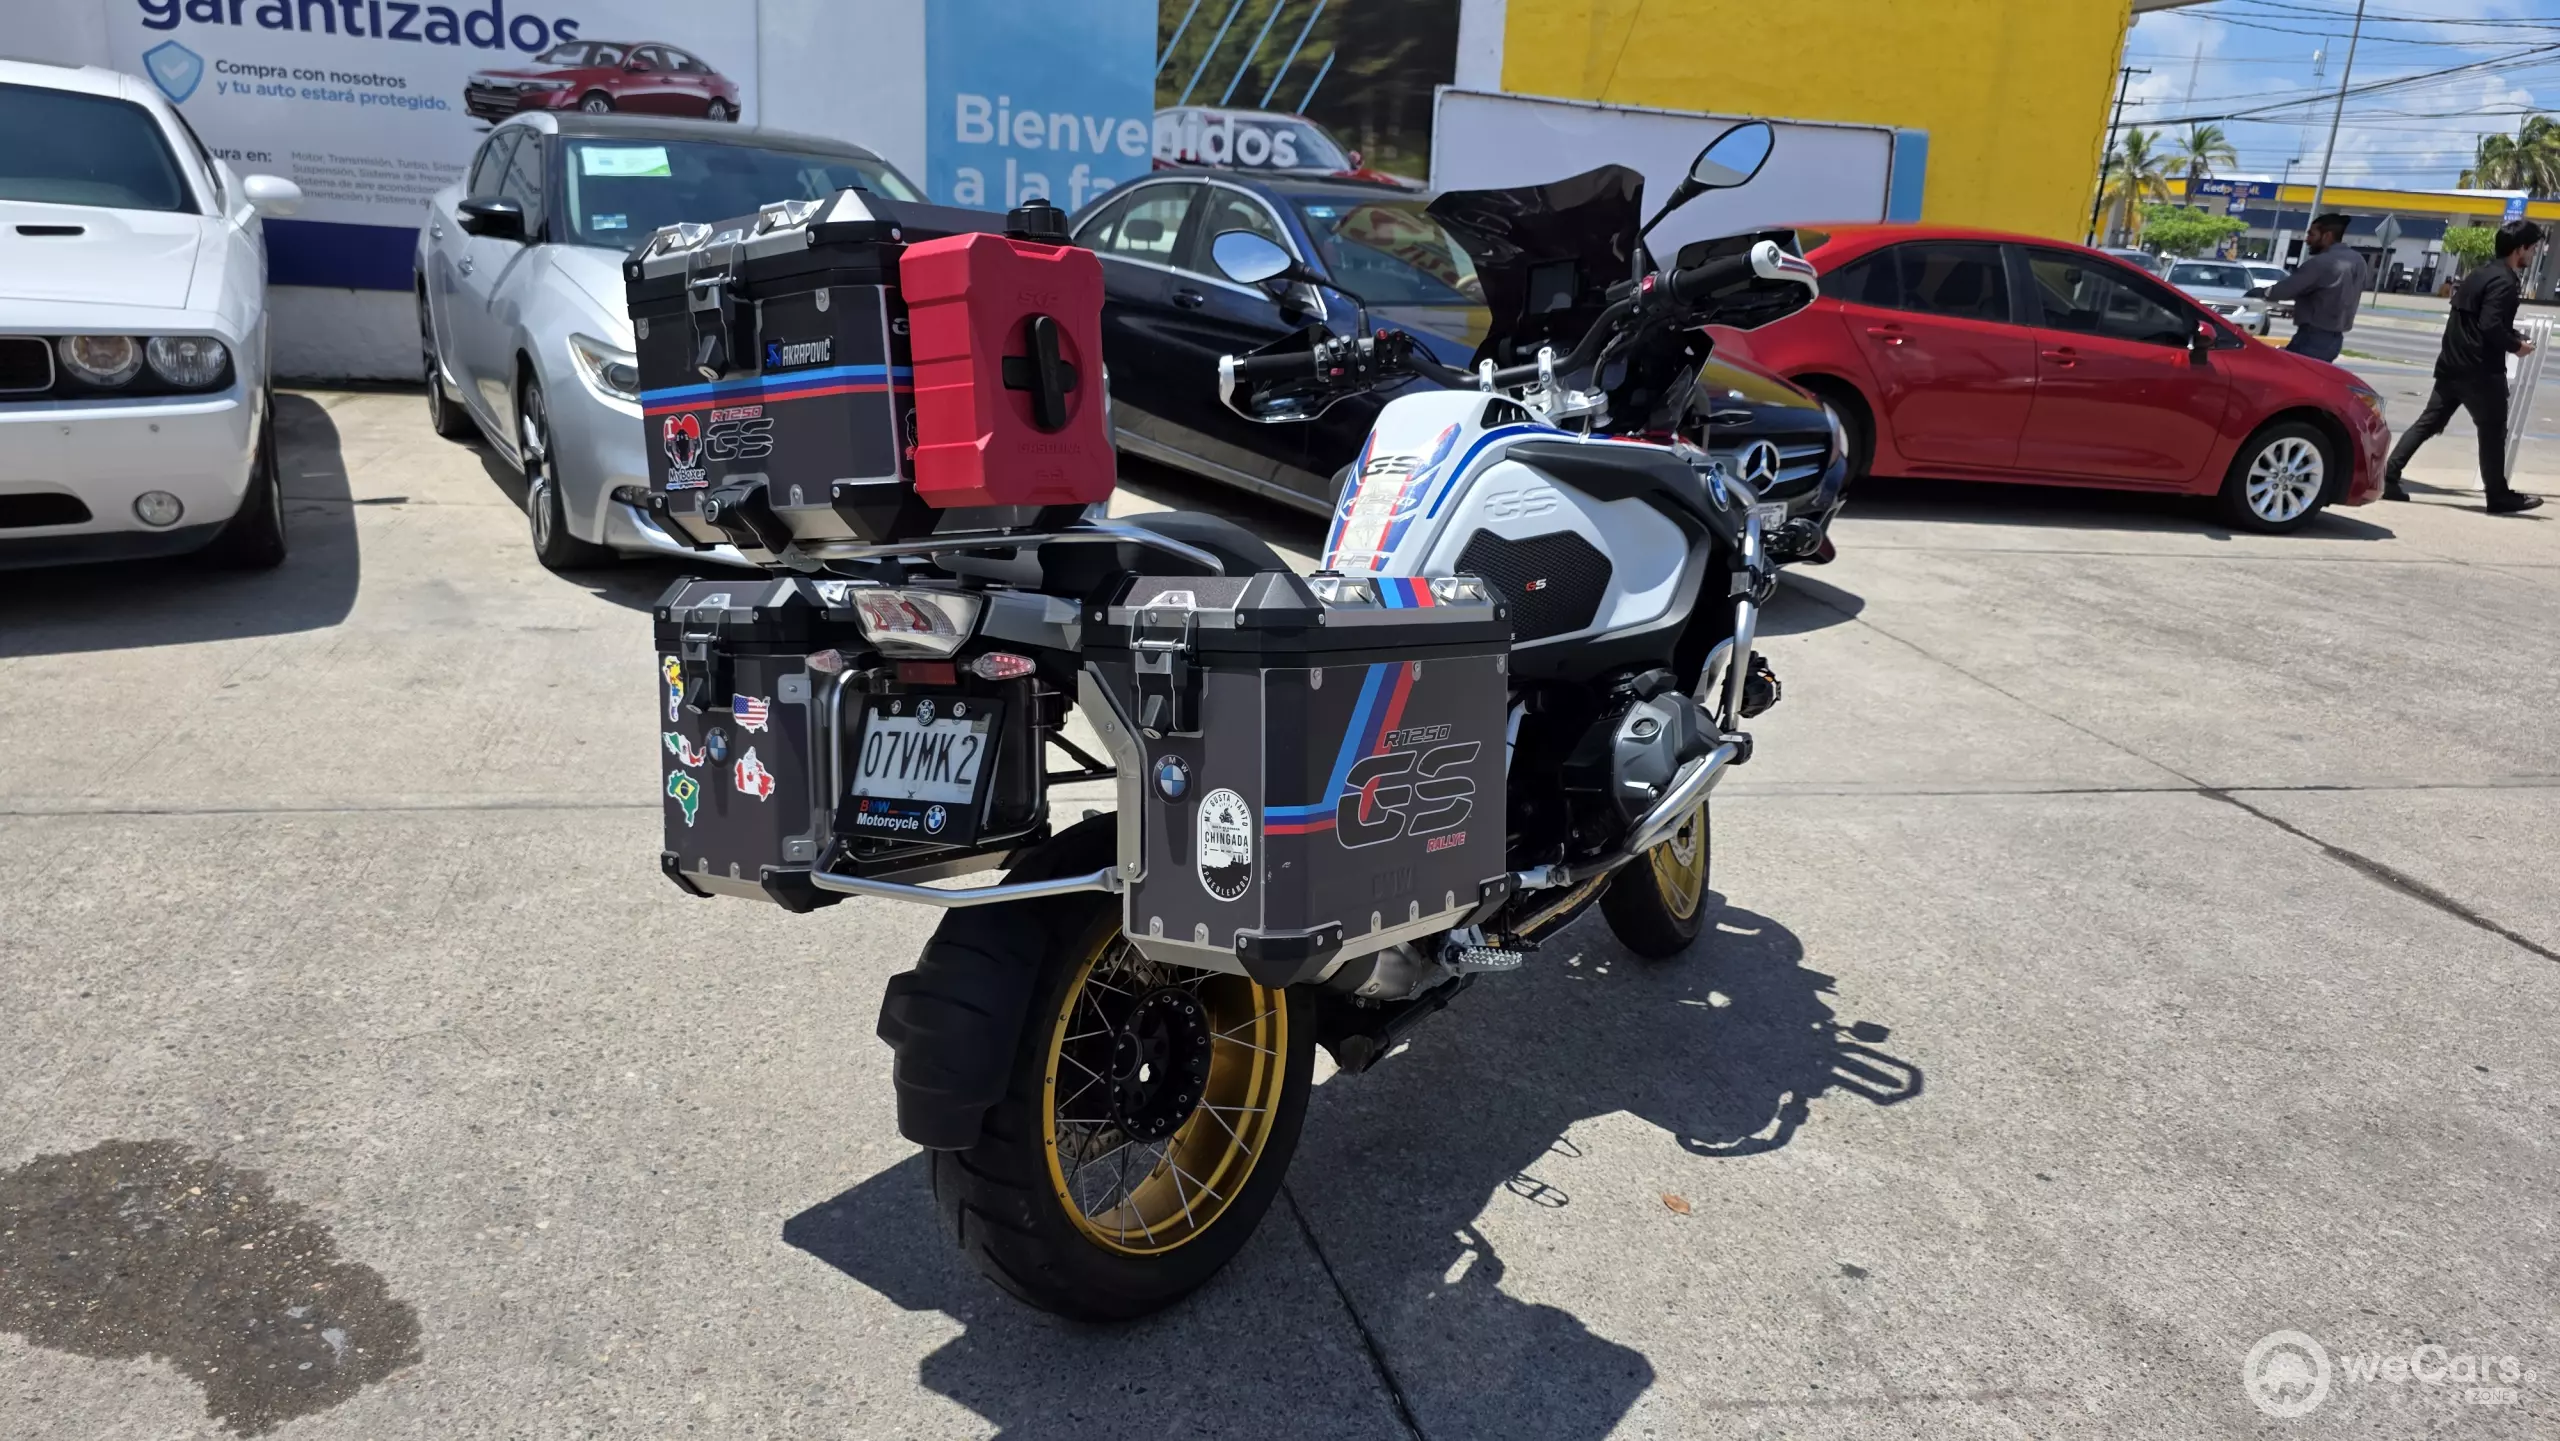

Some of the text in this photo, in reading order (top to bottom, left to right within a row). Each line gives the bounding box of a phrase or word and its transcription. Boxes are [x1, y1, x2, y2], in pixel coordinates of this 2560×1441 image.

[141, 0, 581, 53] garantizados
[215, 59, 407, 89] Compra con nosotros
[217, 80, 452, 112] y tu auto estará protegido.
[955, 93, 1299, 168] Bienvenidos
[246, 149, 273, 163] en:
[291, 151, 326, 164] Motor,
[328, 153, 393, 168] Transmisión,
[292, 164, 357, 178] Suspensión,
[954, 166, 985, 206] a
[1005, 158, 1050, 208] la
[355, 179, 376, 190] aire
[710, 405, 763, 423] R1250
[704, 418, 774, 461] GS
[1483, 485, 1558, 523] GS
[1526, 578, 1547, 591] GS
[1383, 724, 1452, 748] R1250
[864, 731, 979, 785] 07VMK2
[1157, 756, 1189, 773] BMW
[860, 799, 891, 812] BMW
[1336, 741, 1482, 849] GS
[856, 812, 919, 831] Motorcycle
[1210, 793, 1231, 807] GUSTA
[1235, 799, 1249, 827] TANTO
[1204, 831, 1249, 847] CHINGADA
[1426, 831, 1467, 852] RALLYE
[1203, 871, 1249, 896] PUEBLEANDO
